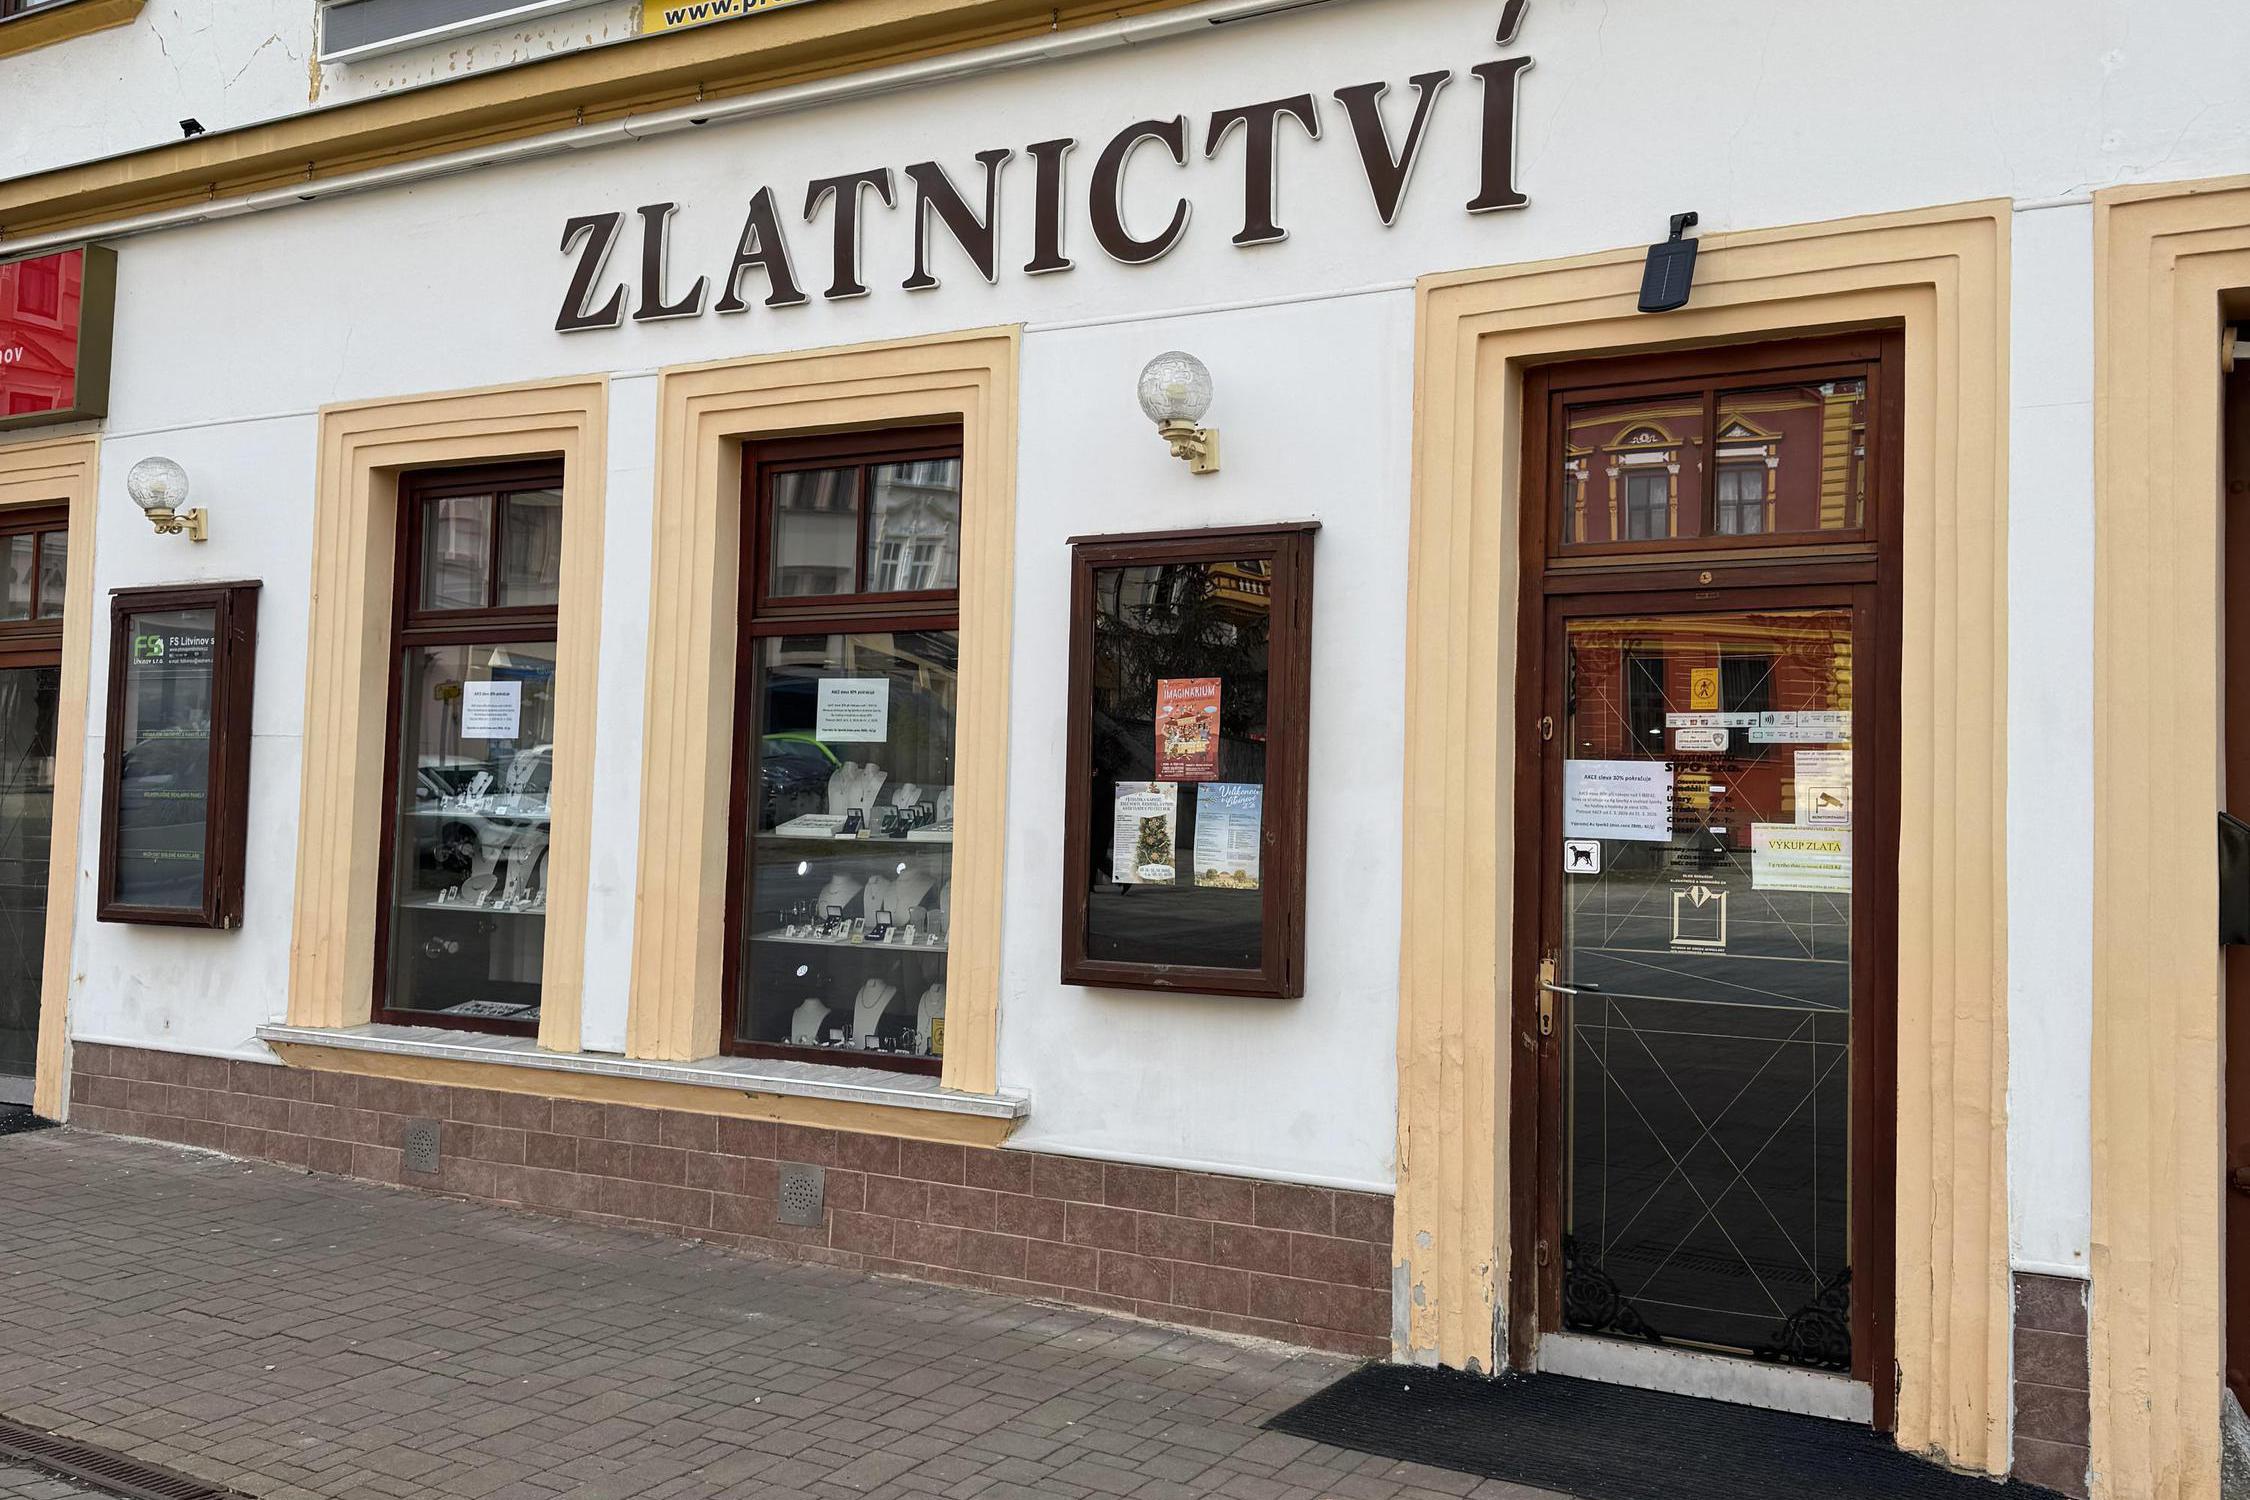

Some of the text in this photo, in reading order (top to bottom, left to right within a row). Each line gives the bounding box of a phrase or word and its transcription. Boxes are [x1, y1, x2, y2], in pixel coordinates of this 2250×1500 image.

[554, 0, 1534, 334] ZLATNICTVÍ
[169, 637, 179, 646] FS
[1164, 685, 1215, 699] IMAGINARIUM
[1768, 839, 1804, 850] VÝKUP
[1806, 841, 1841, 852] ZLATA
